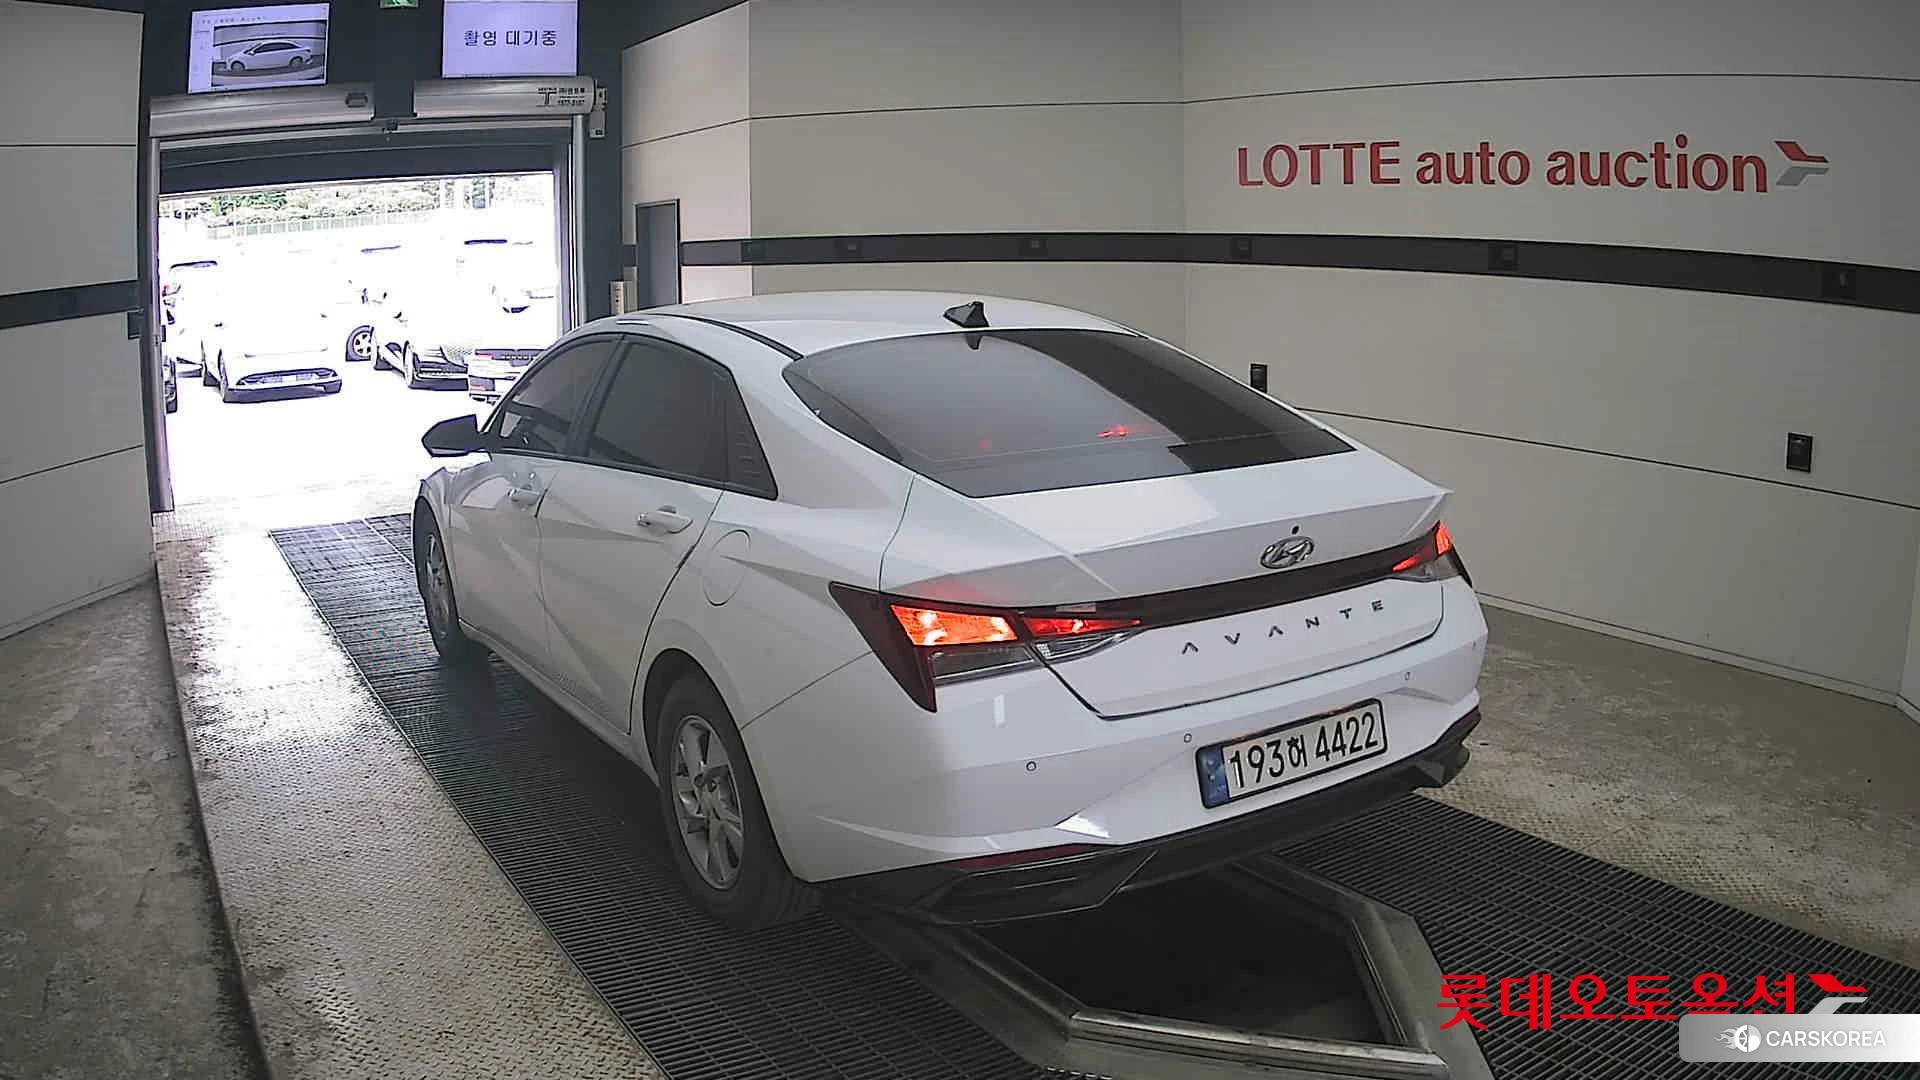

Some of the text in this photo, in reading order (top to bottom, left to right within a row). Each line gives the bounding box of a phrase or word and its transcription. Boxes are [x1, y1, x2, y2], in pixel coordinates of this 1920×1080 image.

[464, 30, 557, 47] 촬영 대기중
[1237, 134, 1769, 193] LOTTE auto auction
[1181, 600, 1384, 655] AVANTE
[1227, 711, 1378, 788] 193허 4422
